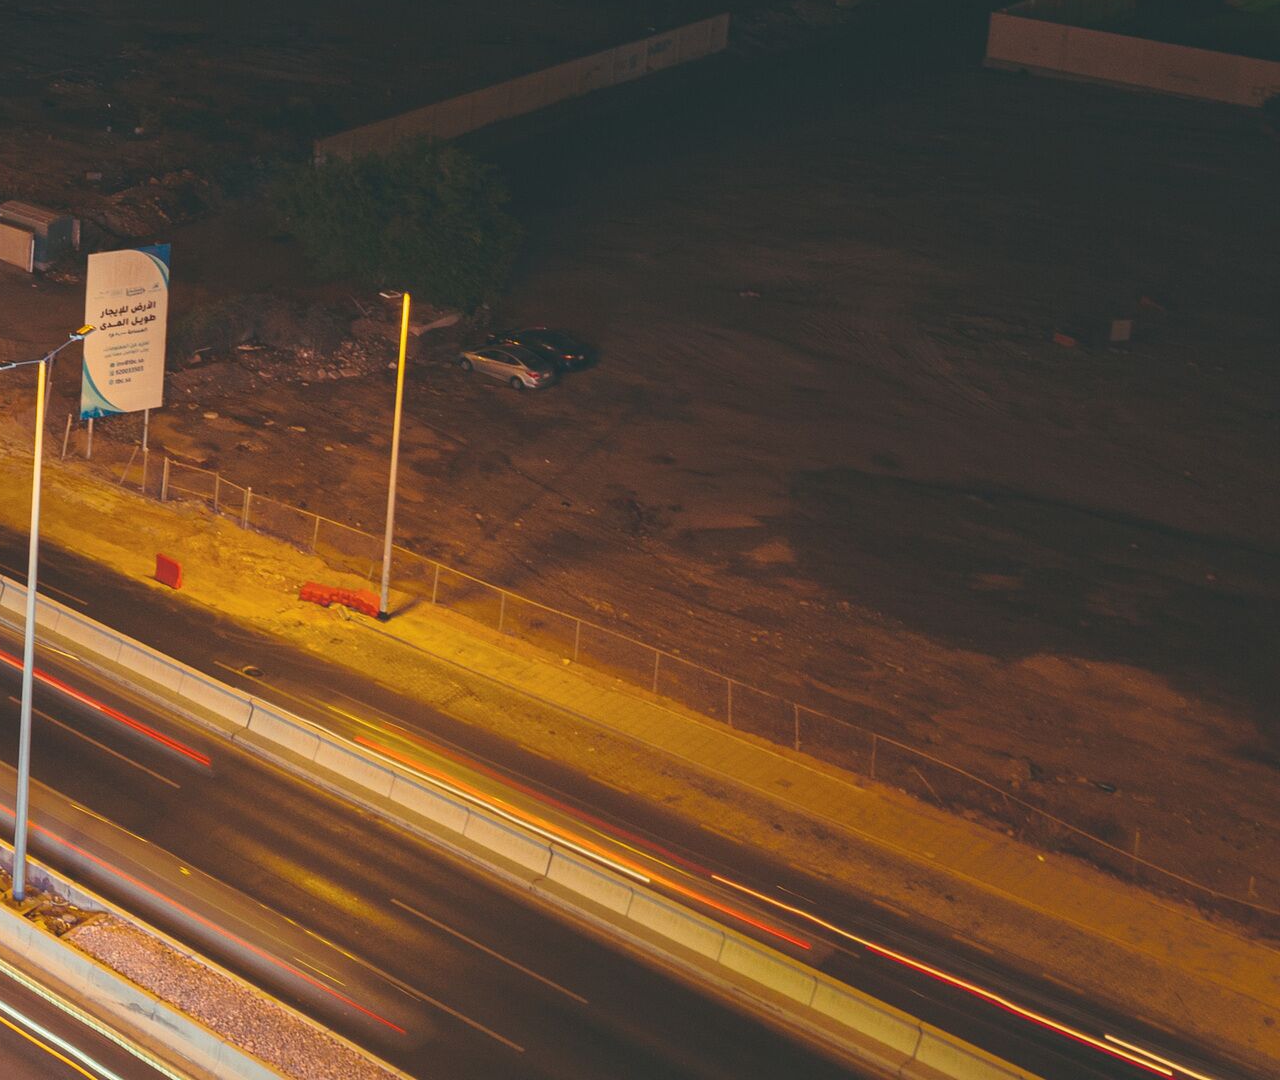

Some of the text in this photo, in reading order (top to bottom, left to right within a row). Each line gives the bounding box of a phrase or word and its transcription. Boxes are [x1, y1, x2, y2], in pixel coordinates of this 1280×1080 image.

[100, 300, 156, 319] الأرض للإيجار
[99, 314, 156, 331] طويل المدى
